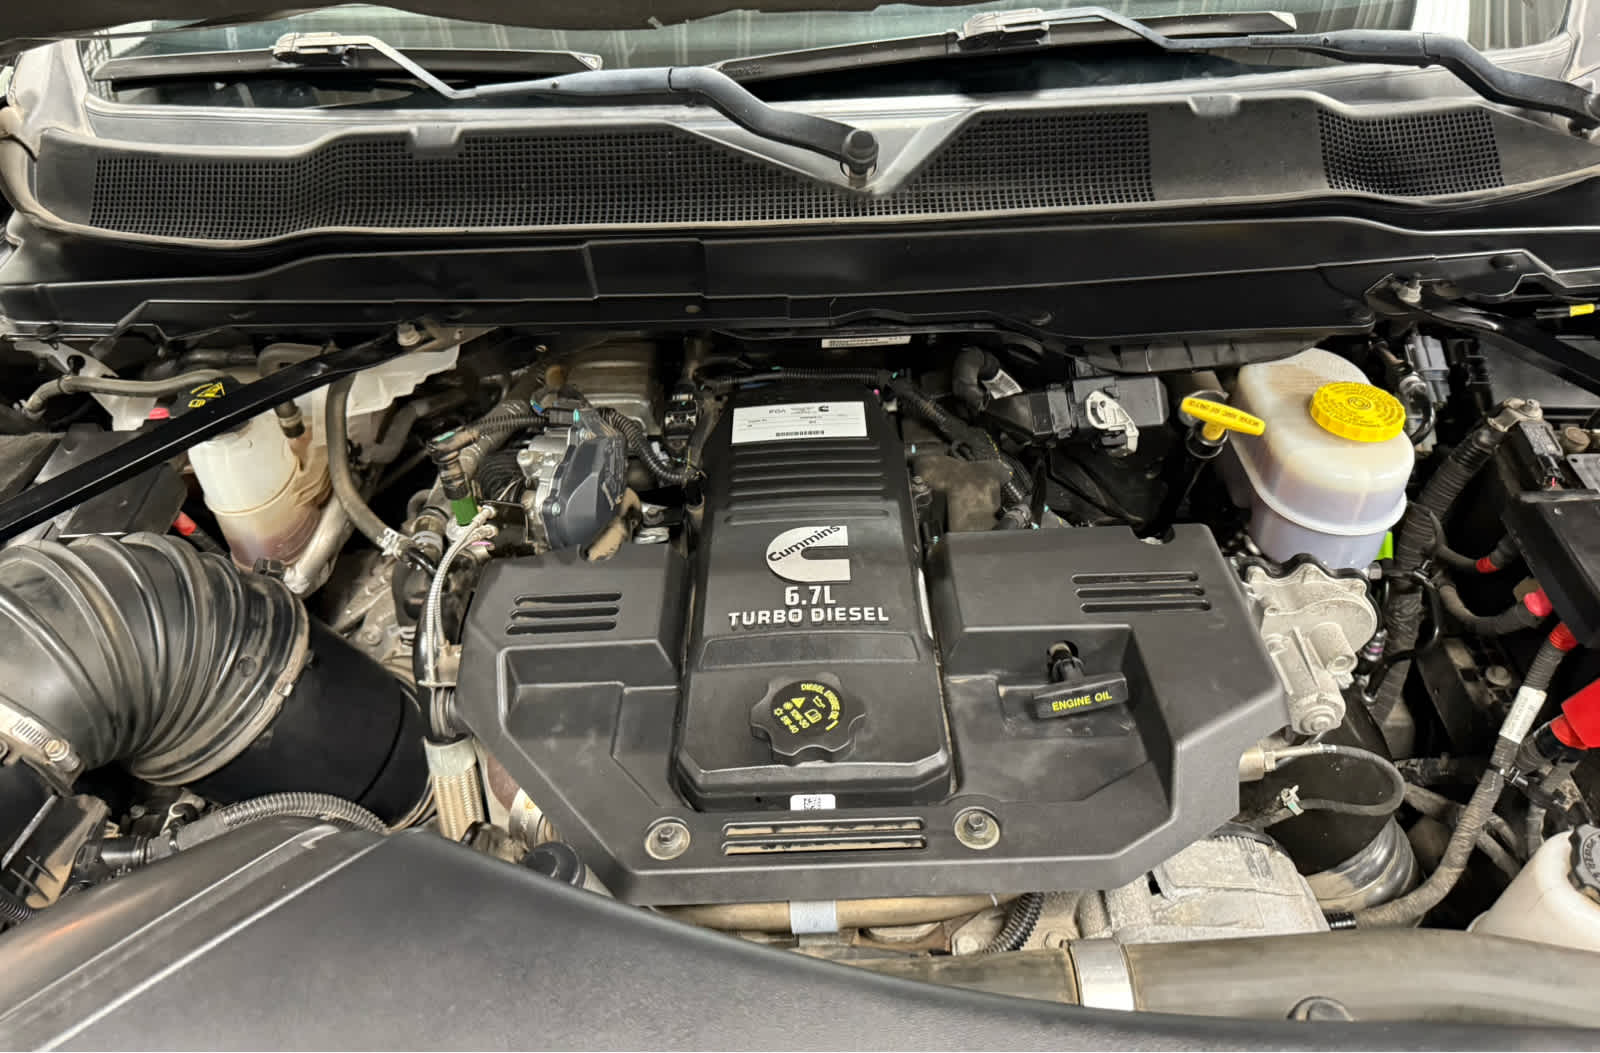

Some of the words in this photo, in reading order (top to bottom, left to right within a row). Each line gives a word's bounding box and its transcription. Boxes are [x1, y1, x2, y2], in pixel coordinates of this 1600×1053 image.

[768, 526, 840, 562] Cummins
[784, 585, 836, 606] 6.7L
[728, 608, 803, 626] TURBO
[810, 607, 889, 622] DIESEL
[800, 683, 825, 695] DIESEL
[1052, 695, 1092, 712] ENGINE
[1094, 691, 1113, 703] OIL
